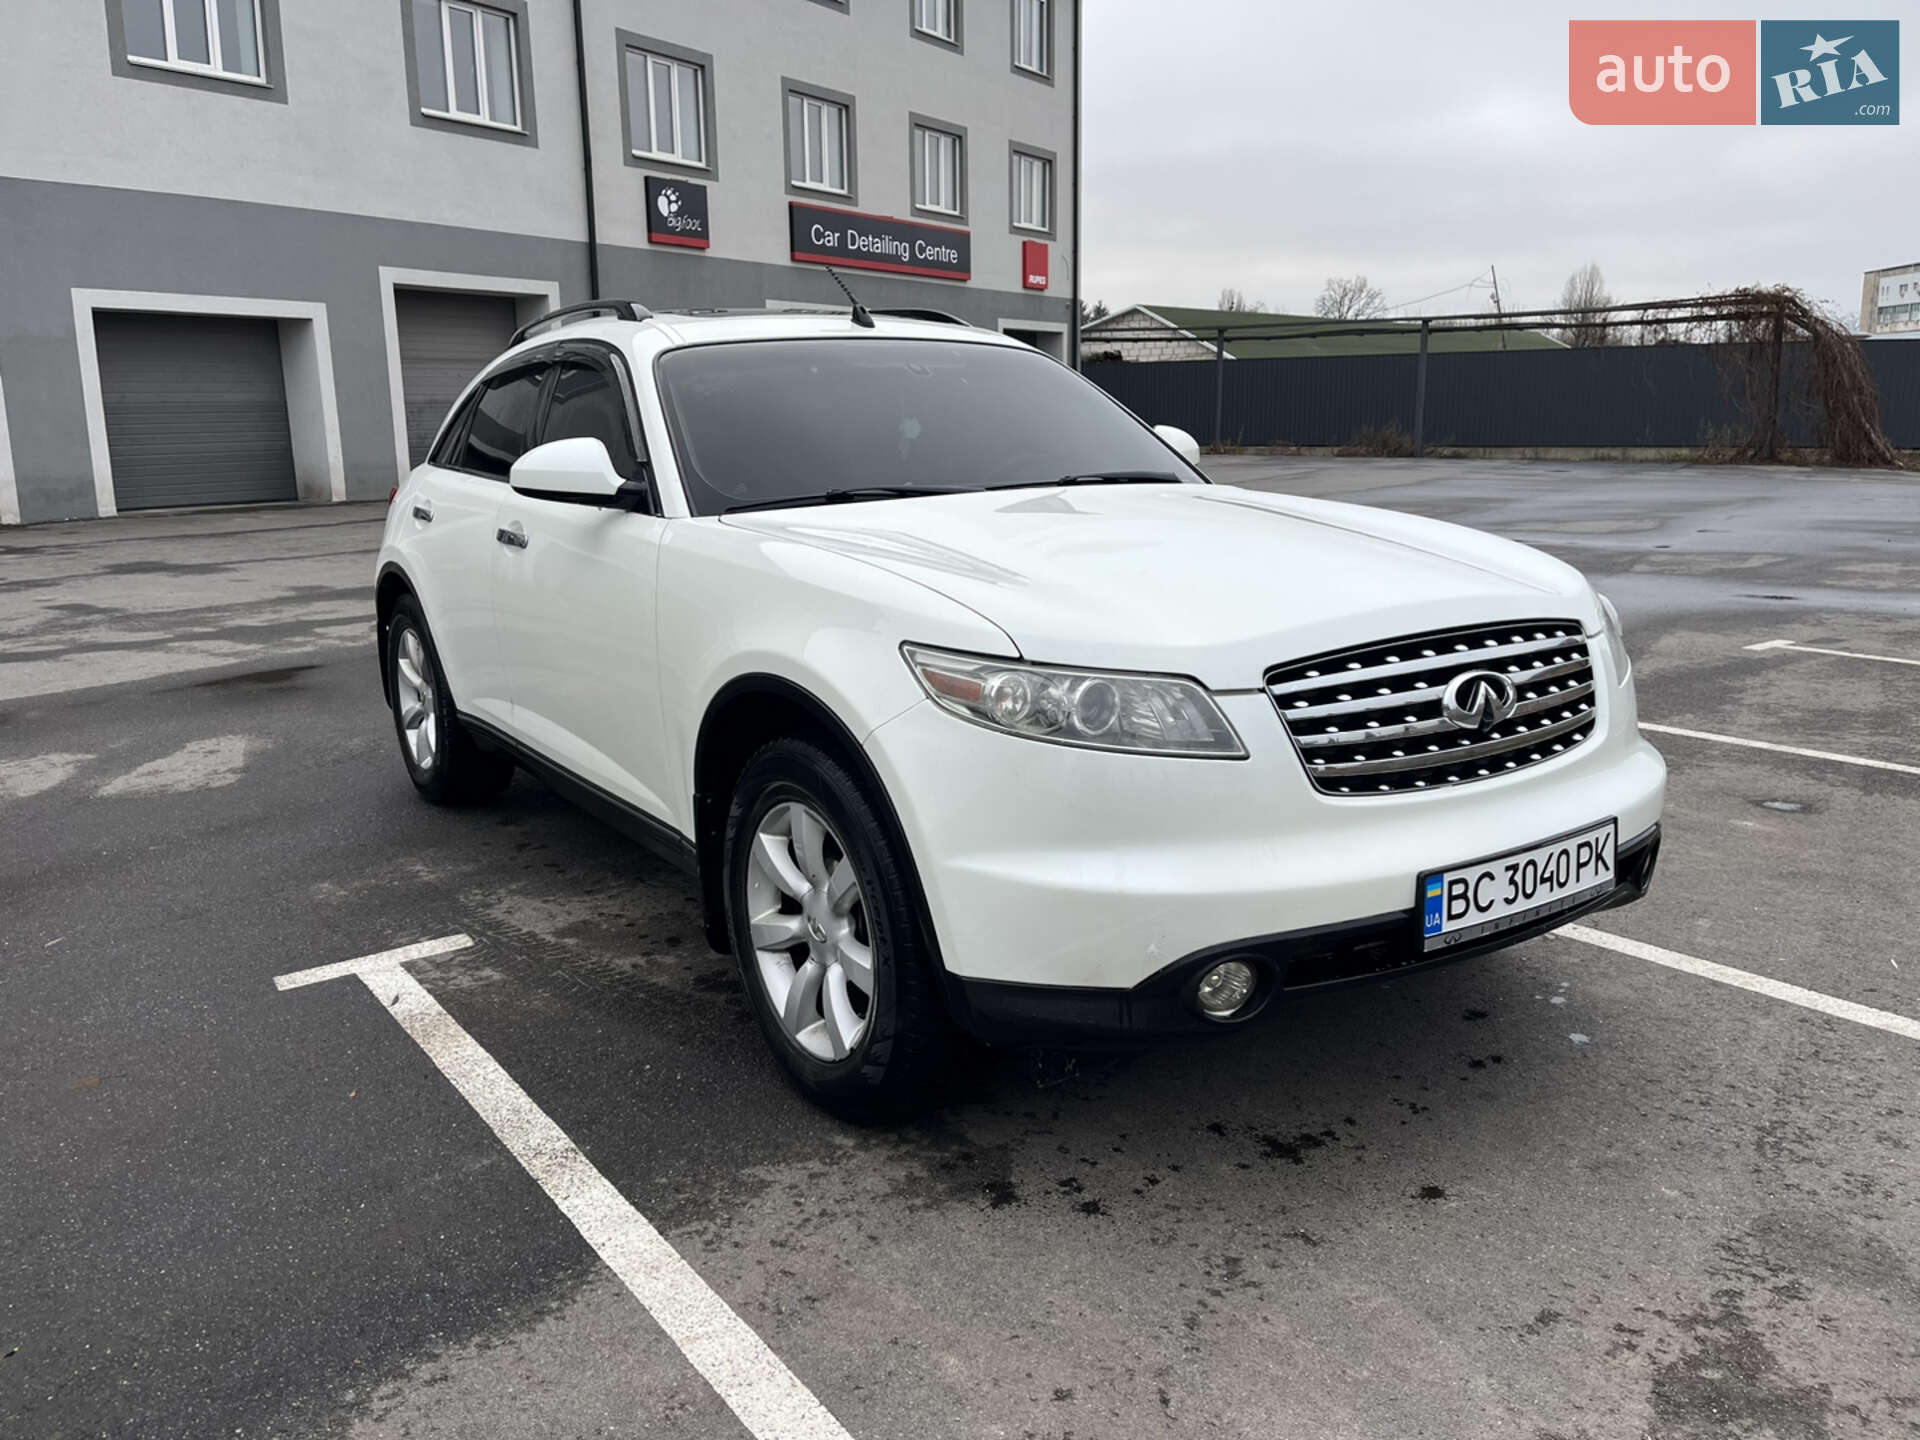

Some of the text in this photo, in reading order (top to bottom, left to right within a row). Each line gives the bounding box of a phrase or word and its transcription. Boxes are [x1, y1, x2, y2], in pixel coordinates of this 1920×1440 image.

[811, 224, 958, 263] Car Detailing Centre
[1447, 831, 1611, 922] BC 3040 PK
[1425, 914, 1441, 928] UA
